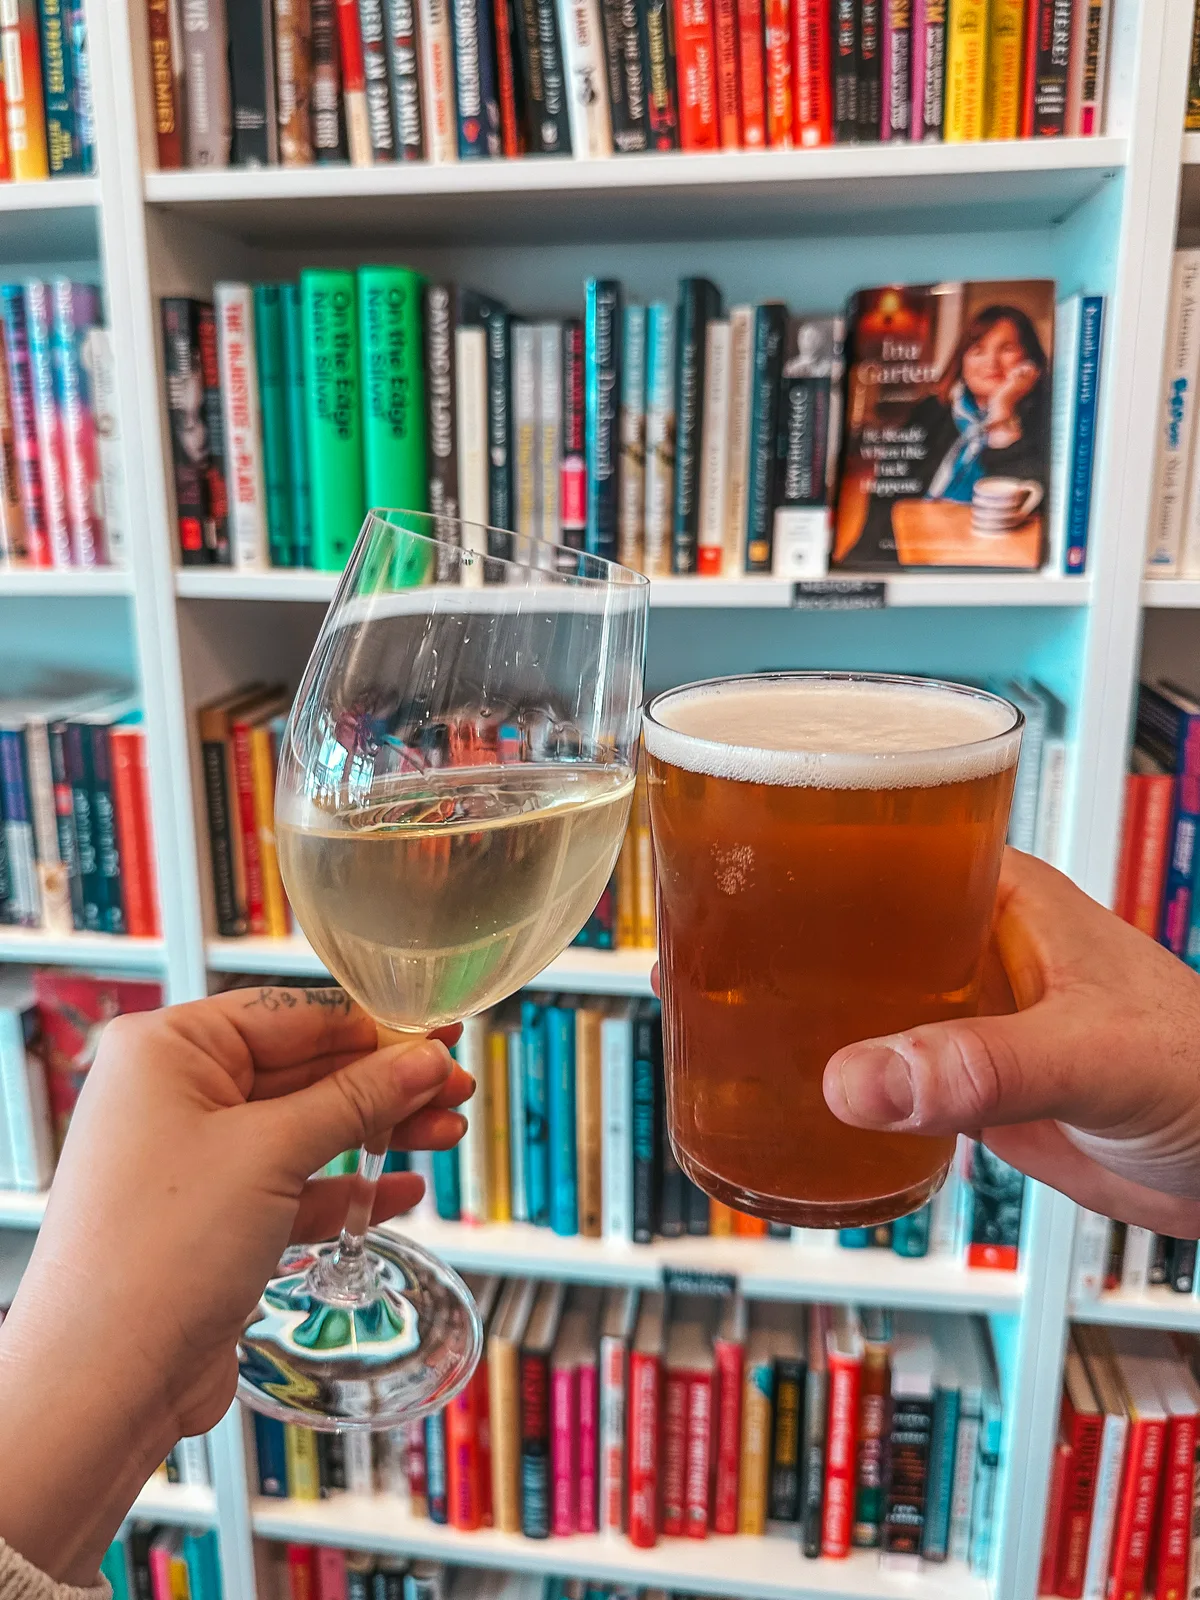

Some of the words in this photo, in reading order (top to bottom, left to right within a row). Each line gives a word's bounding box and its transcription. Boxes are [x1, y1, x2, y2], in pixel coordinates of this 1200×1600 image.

[1083, 7, 1101, 101] REVOLUTION
[152, 38, 175, 133] ENEMIES
[368, 81, 392, 148] FAMILY
[397, 77, 420, 145] FAMILY
[626, 62, 644, 120] DREAM
[226, 302, 244, 333] THE
[312, 292, 330, 350] Nate
[332, 290, 352, 328] On
[367, 290, 386, 347] Nate
[387, 288, 408, 326] On
[428, 286, 450, 373] SAYING
[596, 290, 615, 366] Tammy
[1082, 305, 1099, 358] Kamala
[333, 332, 352, 373] the
[388, 331, 408, 370] the
[858, 362, 941, 385] Garten
[313, 356, 334, 421] Silver
[332, 379, 354, 440] Edge
[368, 353, 390, 420] Silver
[387, 376, 410, 440] Edge
[433, 396, 454, 457] LOUD
[596, 367, 616, 481] Duckworth
